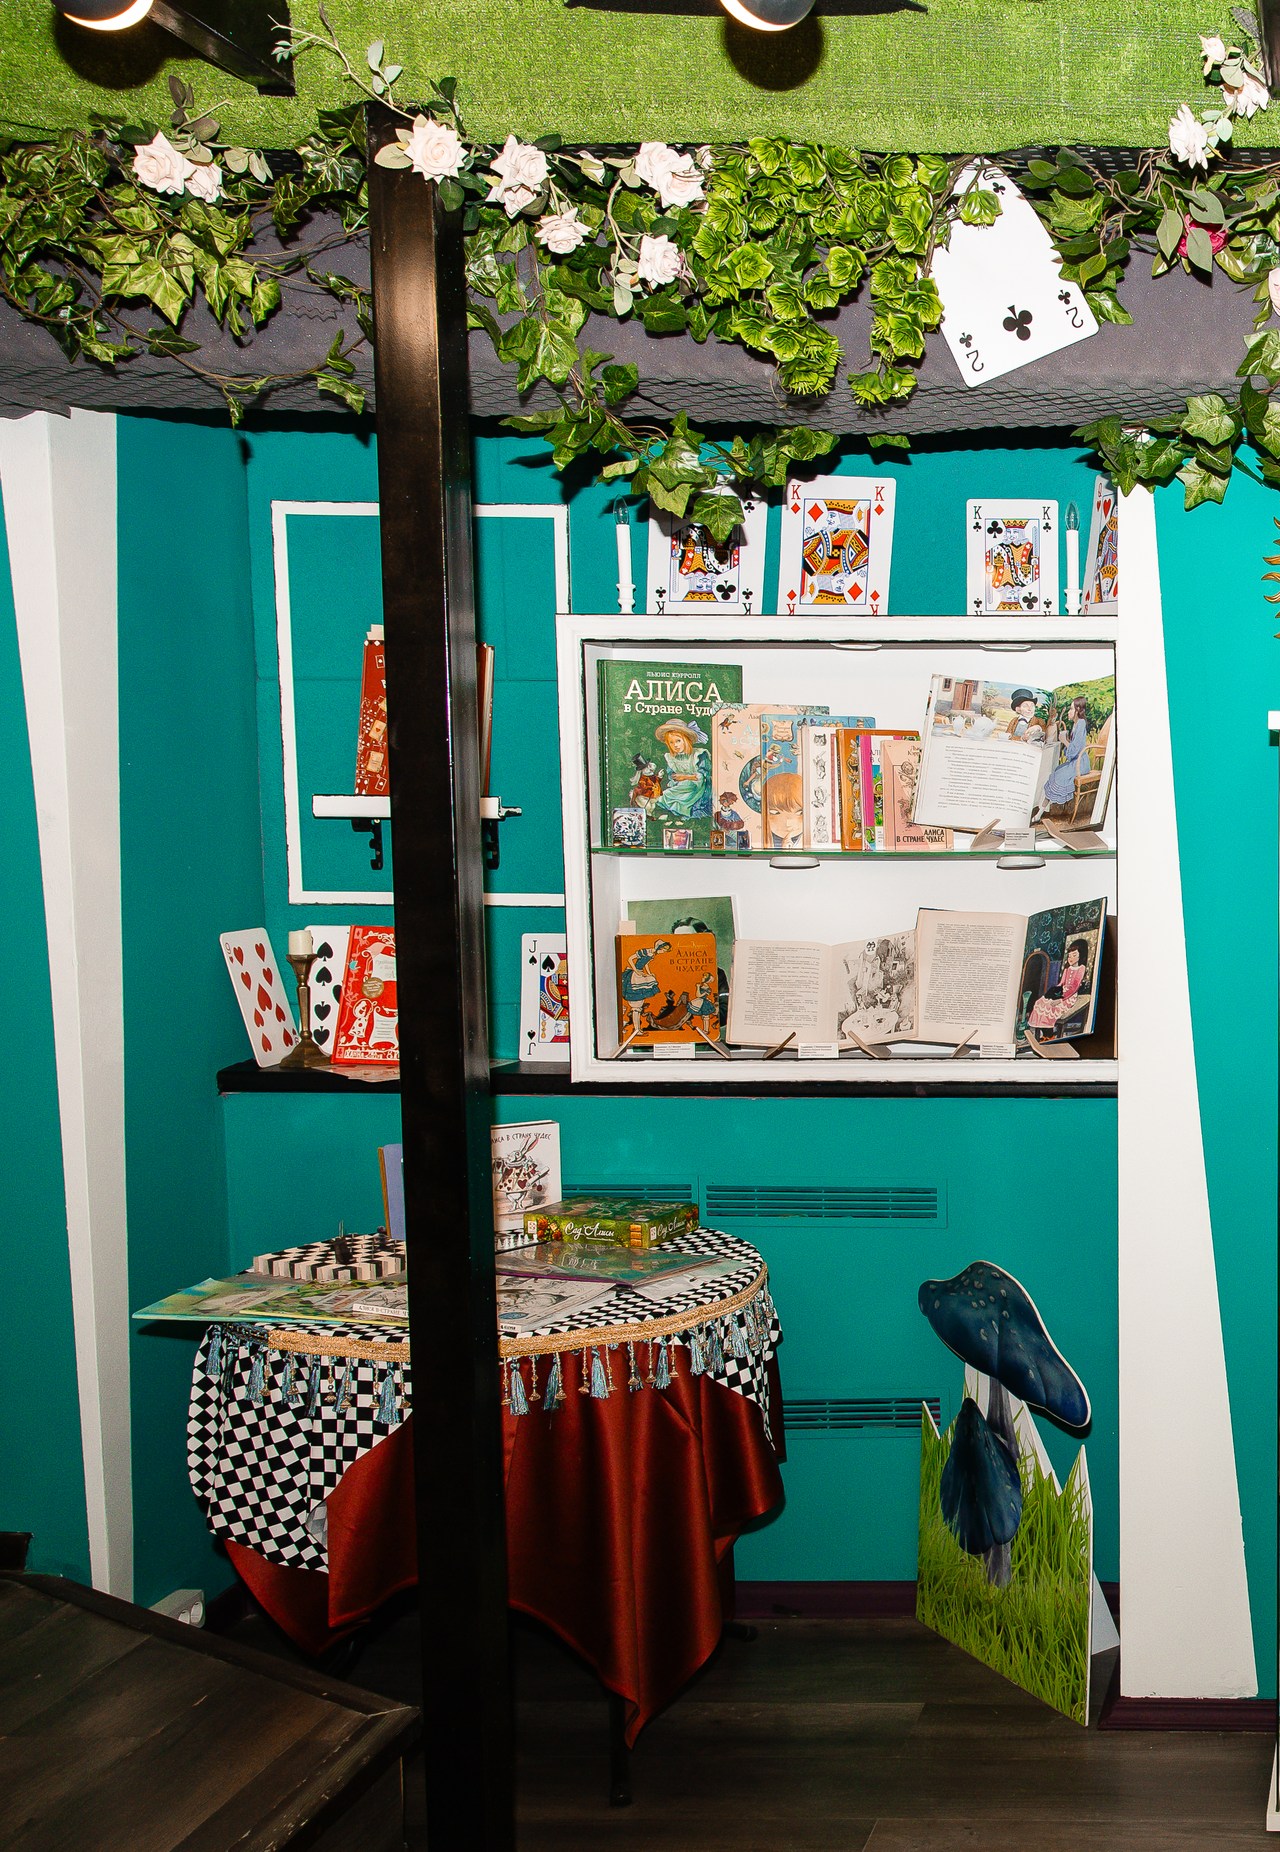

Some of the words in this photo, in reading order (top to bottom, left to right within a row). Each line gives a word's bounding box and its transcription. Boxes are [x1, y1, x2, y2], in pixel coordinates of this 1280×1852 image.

[1066, 307, 1083, 328] 2
[966, 350, 984, 372] 2
[791, 485, 801, 500] K
[874, 486, 885, 501] K
[973, 506, 982, 519] K
[1042, 506, 1051, 520] K
[624, 679, 724, 703] АЛИСА
[624, 704, 631, 713] в
[635, 702, 683, 716] Стране
[529, 940, 537, 953] J
[527, 1042, 536, 1055] J
[564, 1222, 583, 1240] Сад
[583, 1222, 615, 1237] Алисы
